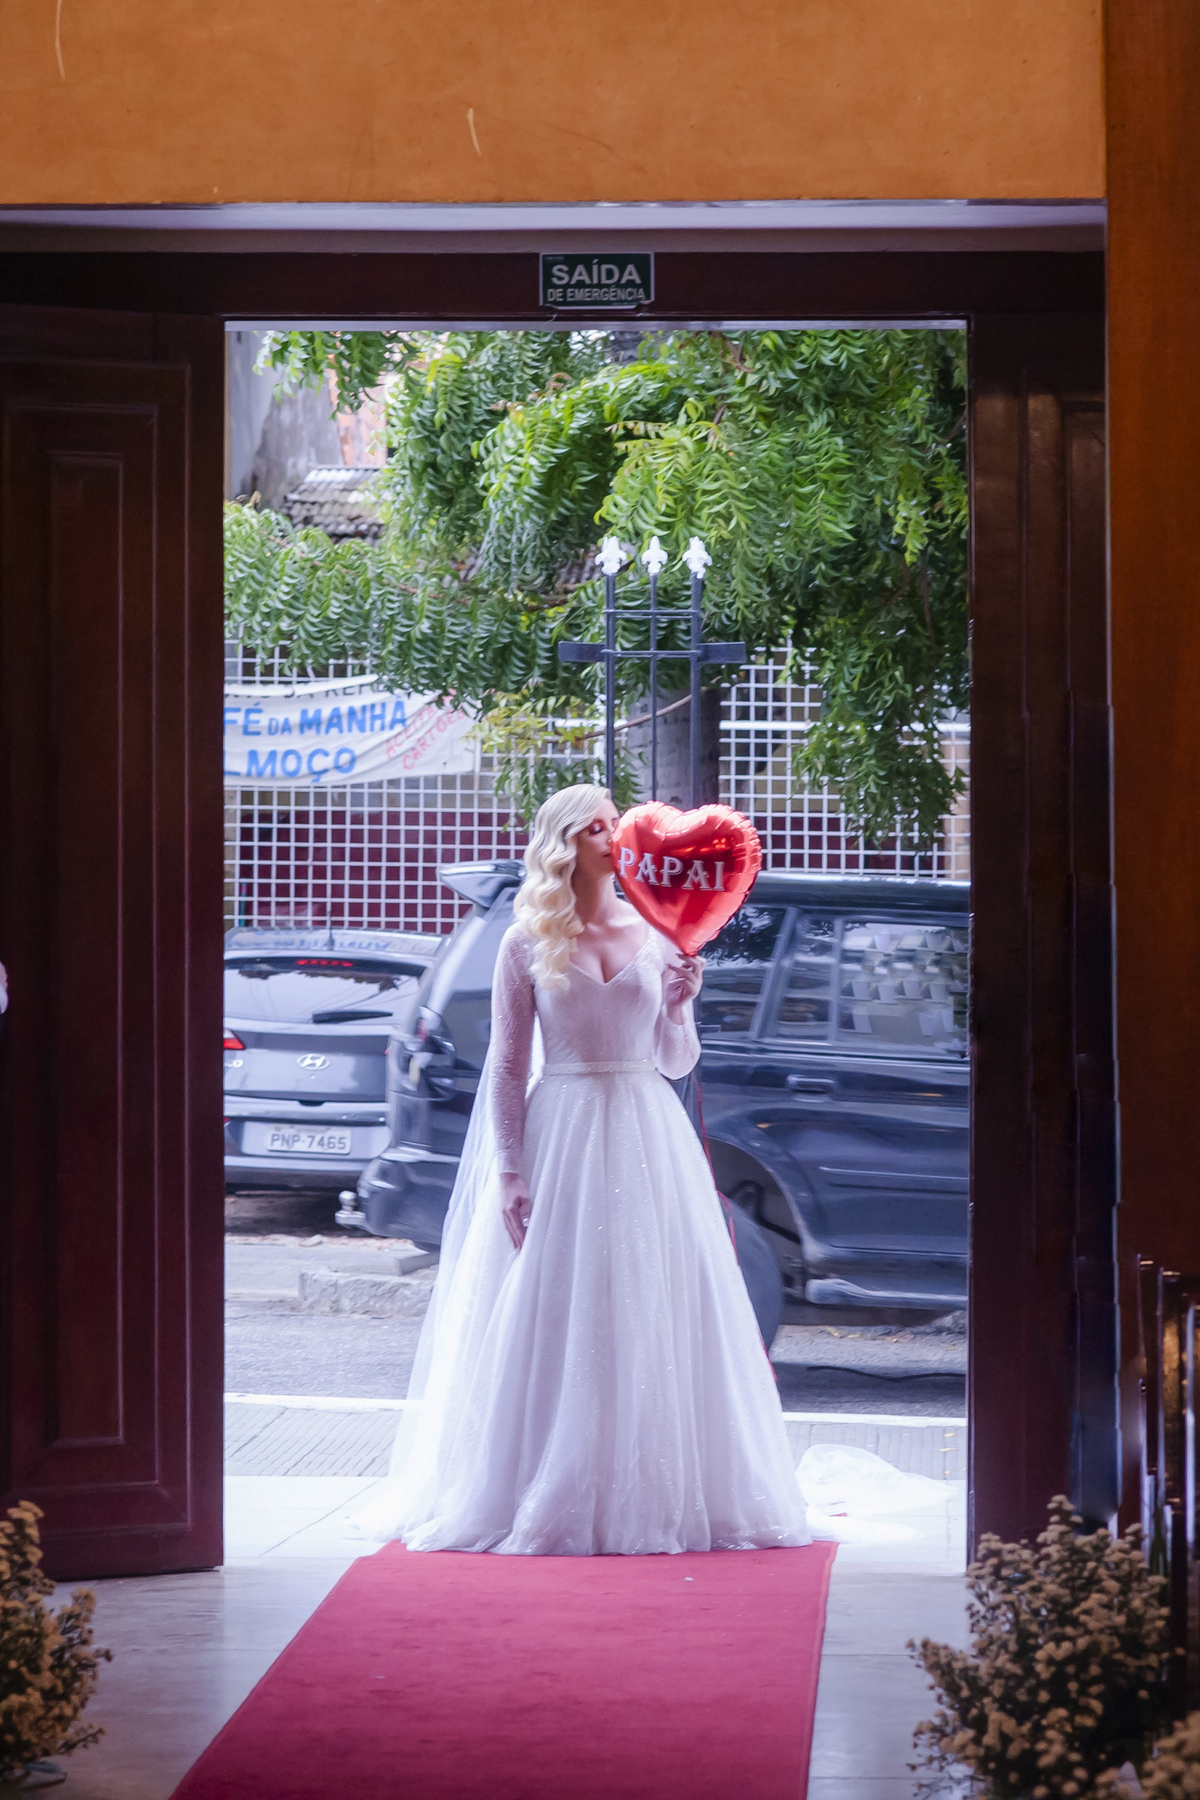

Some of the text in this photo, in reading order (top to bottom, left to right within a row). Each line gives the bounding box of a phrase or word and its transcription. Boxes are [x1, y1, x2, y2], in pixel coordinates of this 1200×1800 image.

[551, 258, 642, 285] SAÍDA
[546, 288, 564, 302] DE
[267, 717, 292, 736] DA
[618, 846, 726, 892] PAPAI
